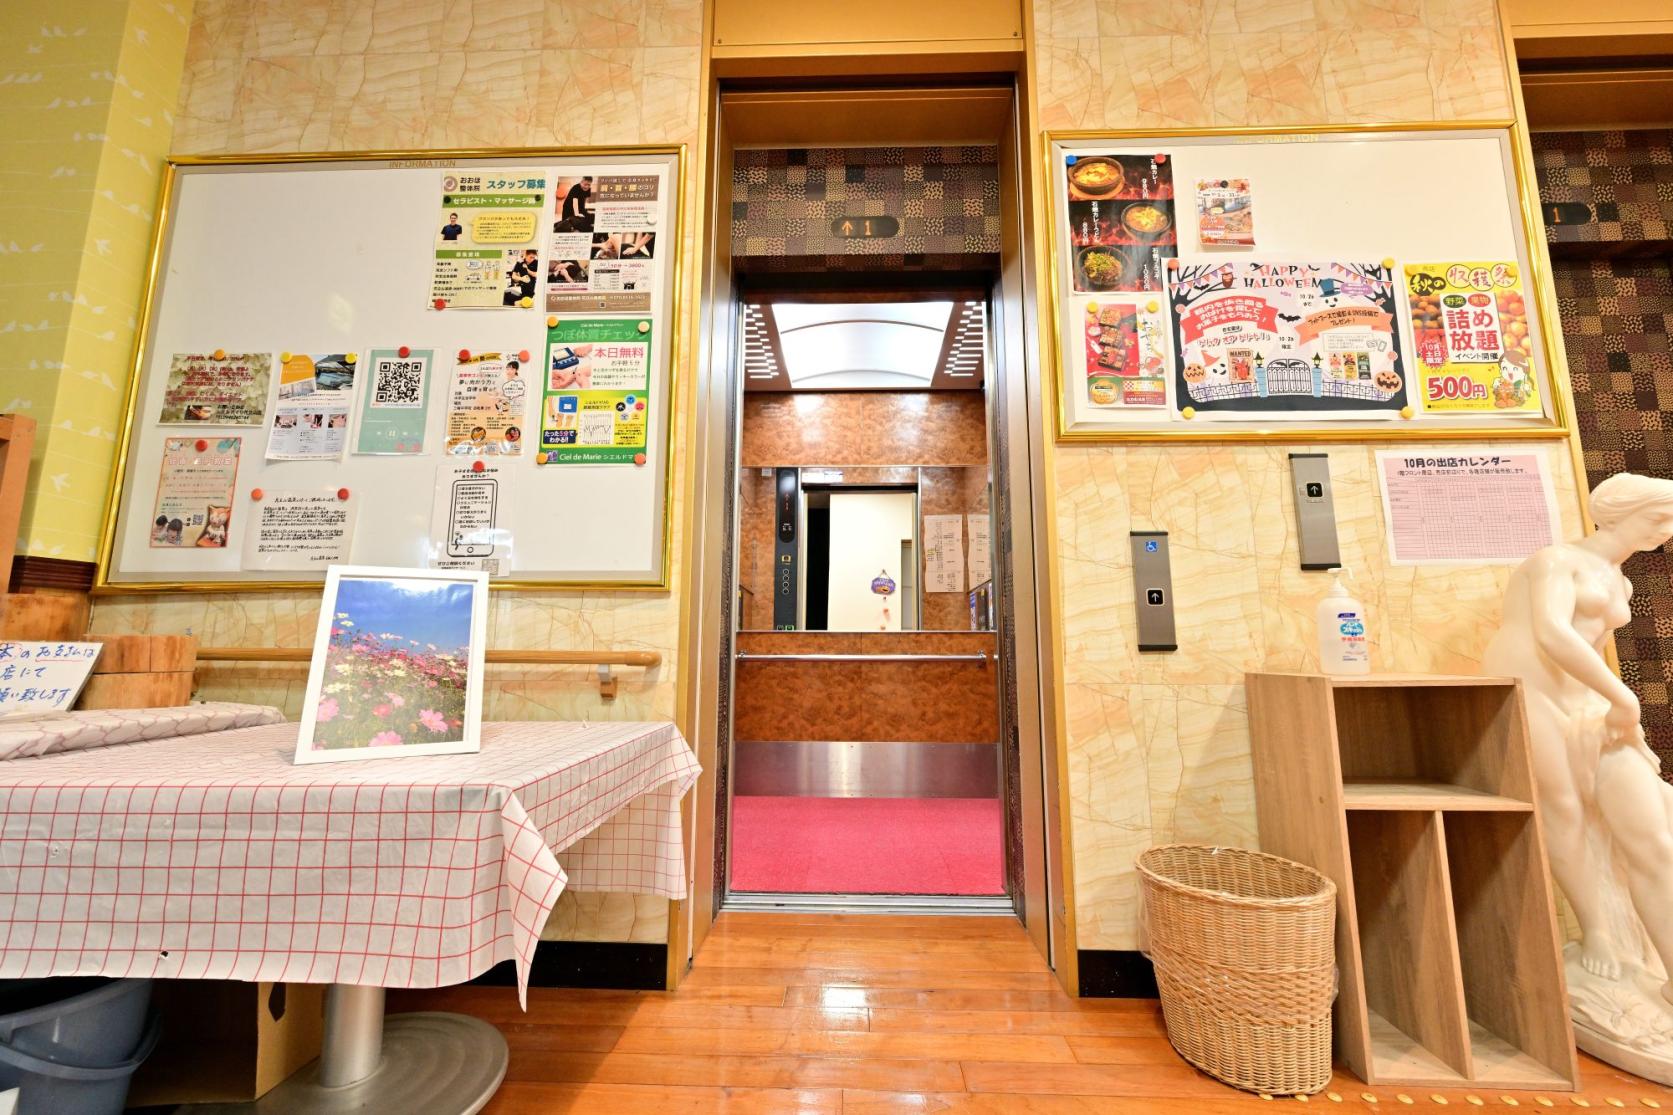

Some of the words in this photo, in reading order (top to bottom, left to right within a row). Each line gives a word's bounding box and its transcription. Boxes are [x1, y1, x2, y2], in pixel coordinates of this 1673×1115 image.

[390, 160, 456, 168] INFORMATION
[487, 179, 546, 189] スタッフ募集
[1553, 207, 1560, 224] 1
[864, 220, 871, 235] 1
[1259, 264, 1307, 276] HAPPY
[1244, 277, 1320, 288] HALLOWEEN
[1410, 273, 1445, 294] 秋の
[1445, 297, 1464, 305] 野菜
[1446, 309, 1494, 330] 詰め
[1449, 330, 1500, 351] 放題
[595, 347, 644, 359] 本日無料
[1455, 352, 1500, 360] イベント開催
[1428, 376, 1487, 400] 500円
[1404, 457, 1511, 468] 10月の出店カレンダー
